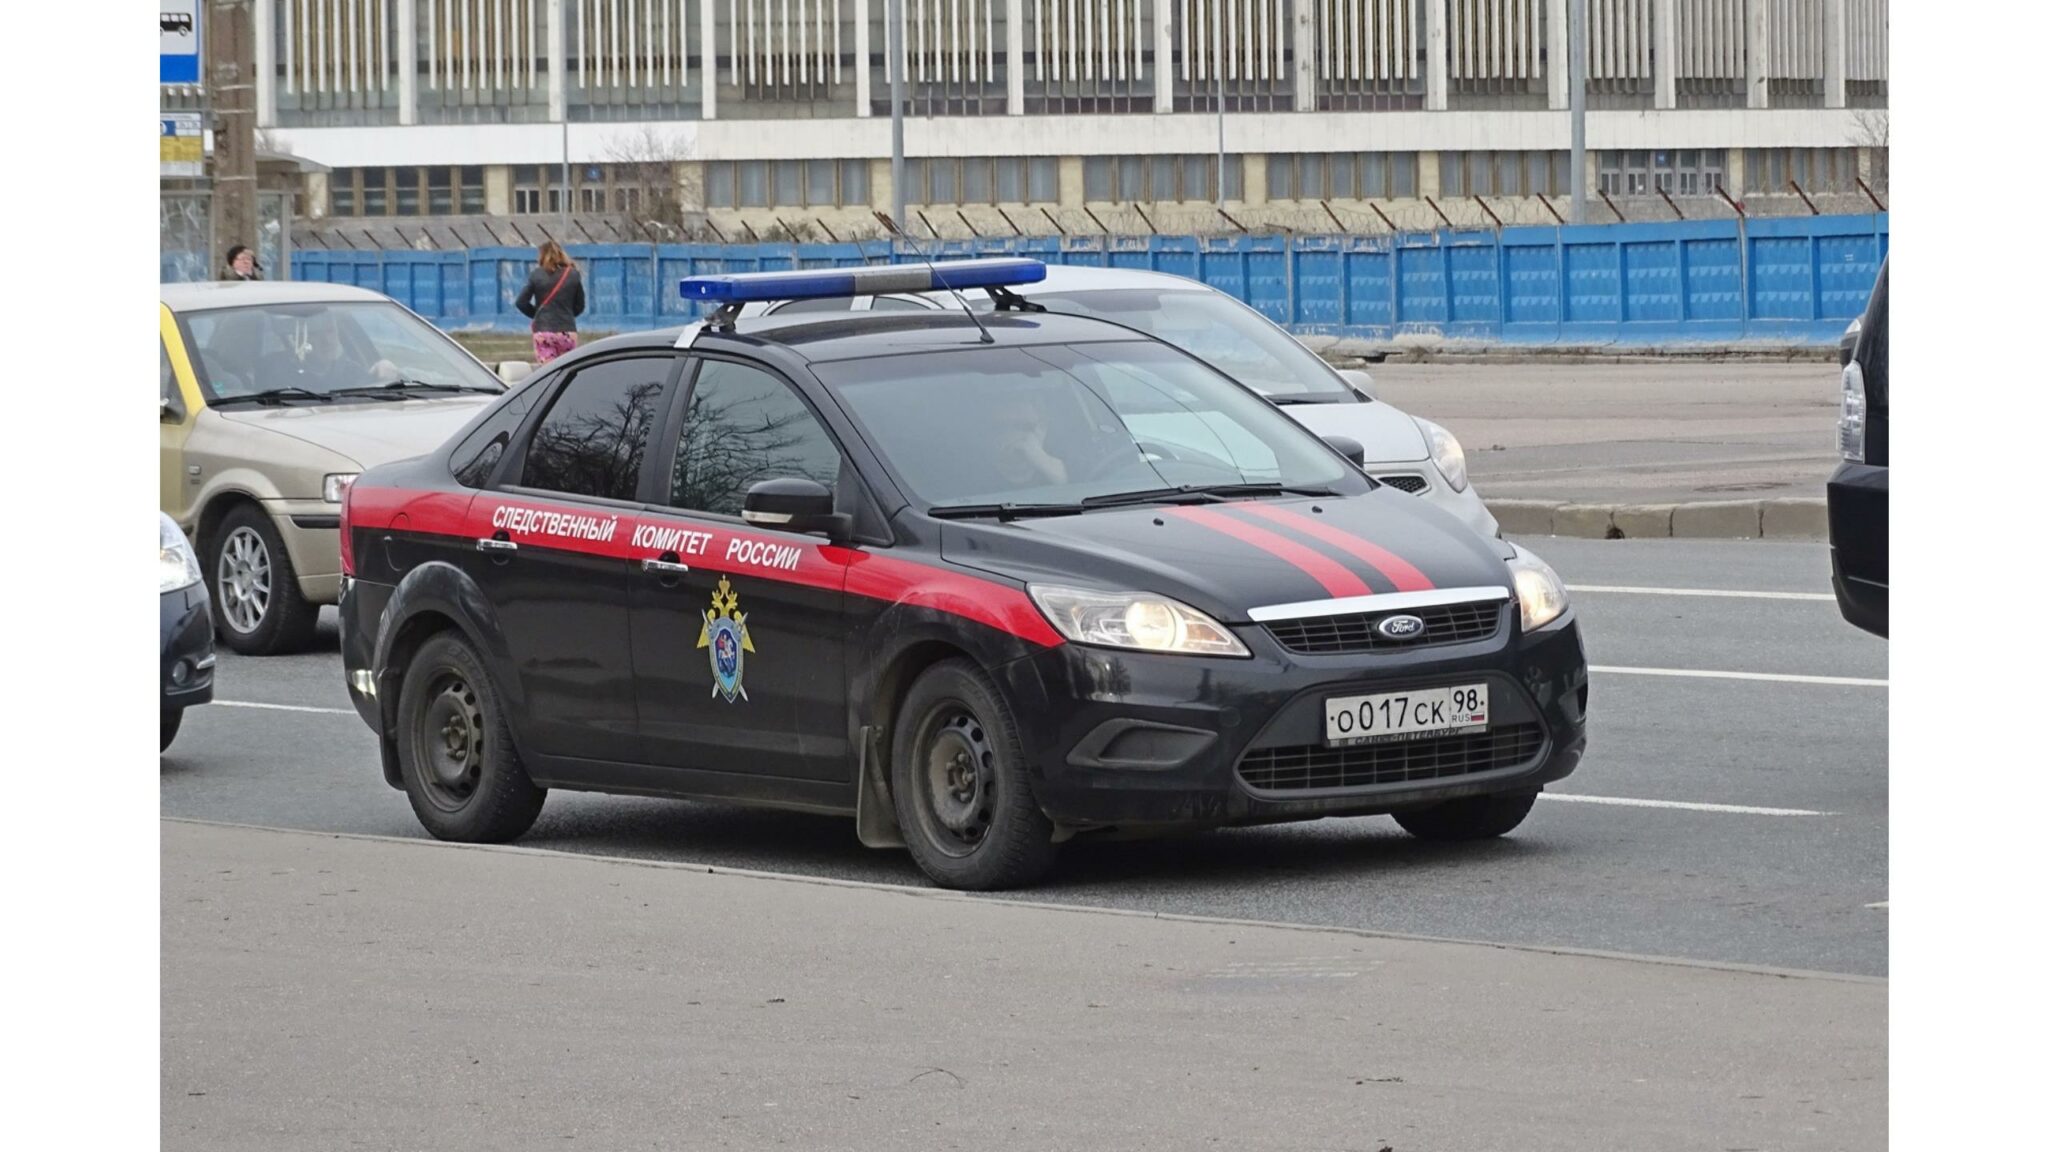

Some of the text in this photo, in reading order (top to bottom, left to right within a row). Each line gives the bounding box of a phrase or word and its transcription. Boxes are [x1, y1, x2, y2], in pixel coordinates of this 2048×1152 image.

[492, 505, 801, 571] СЛЕДСТВЕННЫЙ КОМИТЕТ РОССИИ
[1391, 619, 1415, 633] Ford
[1453, 689, 1478, 713] 98
[1451, 713, 1471, 723] RUS
